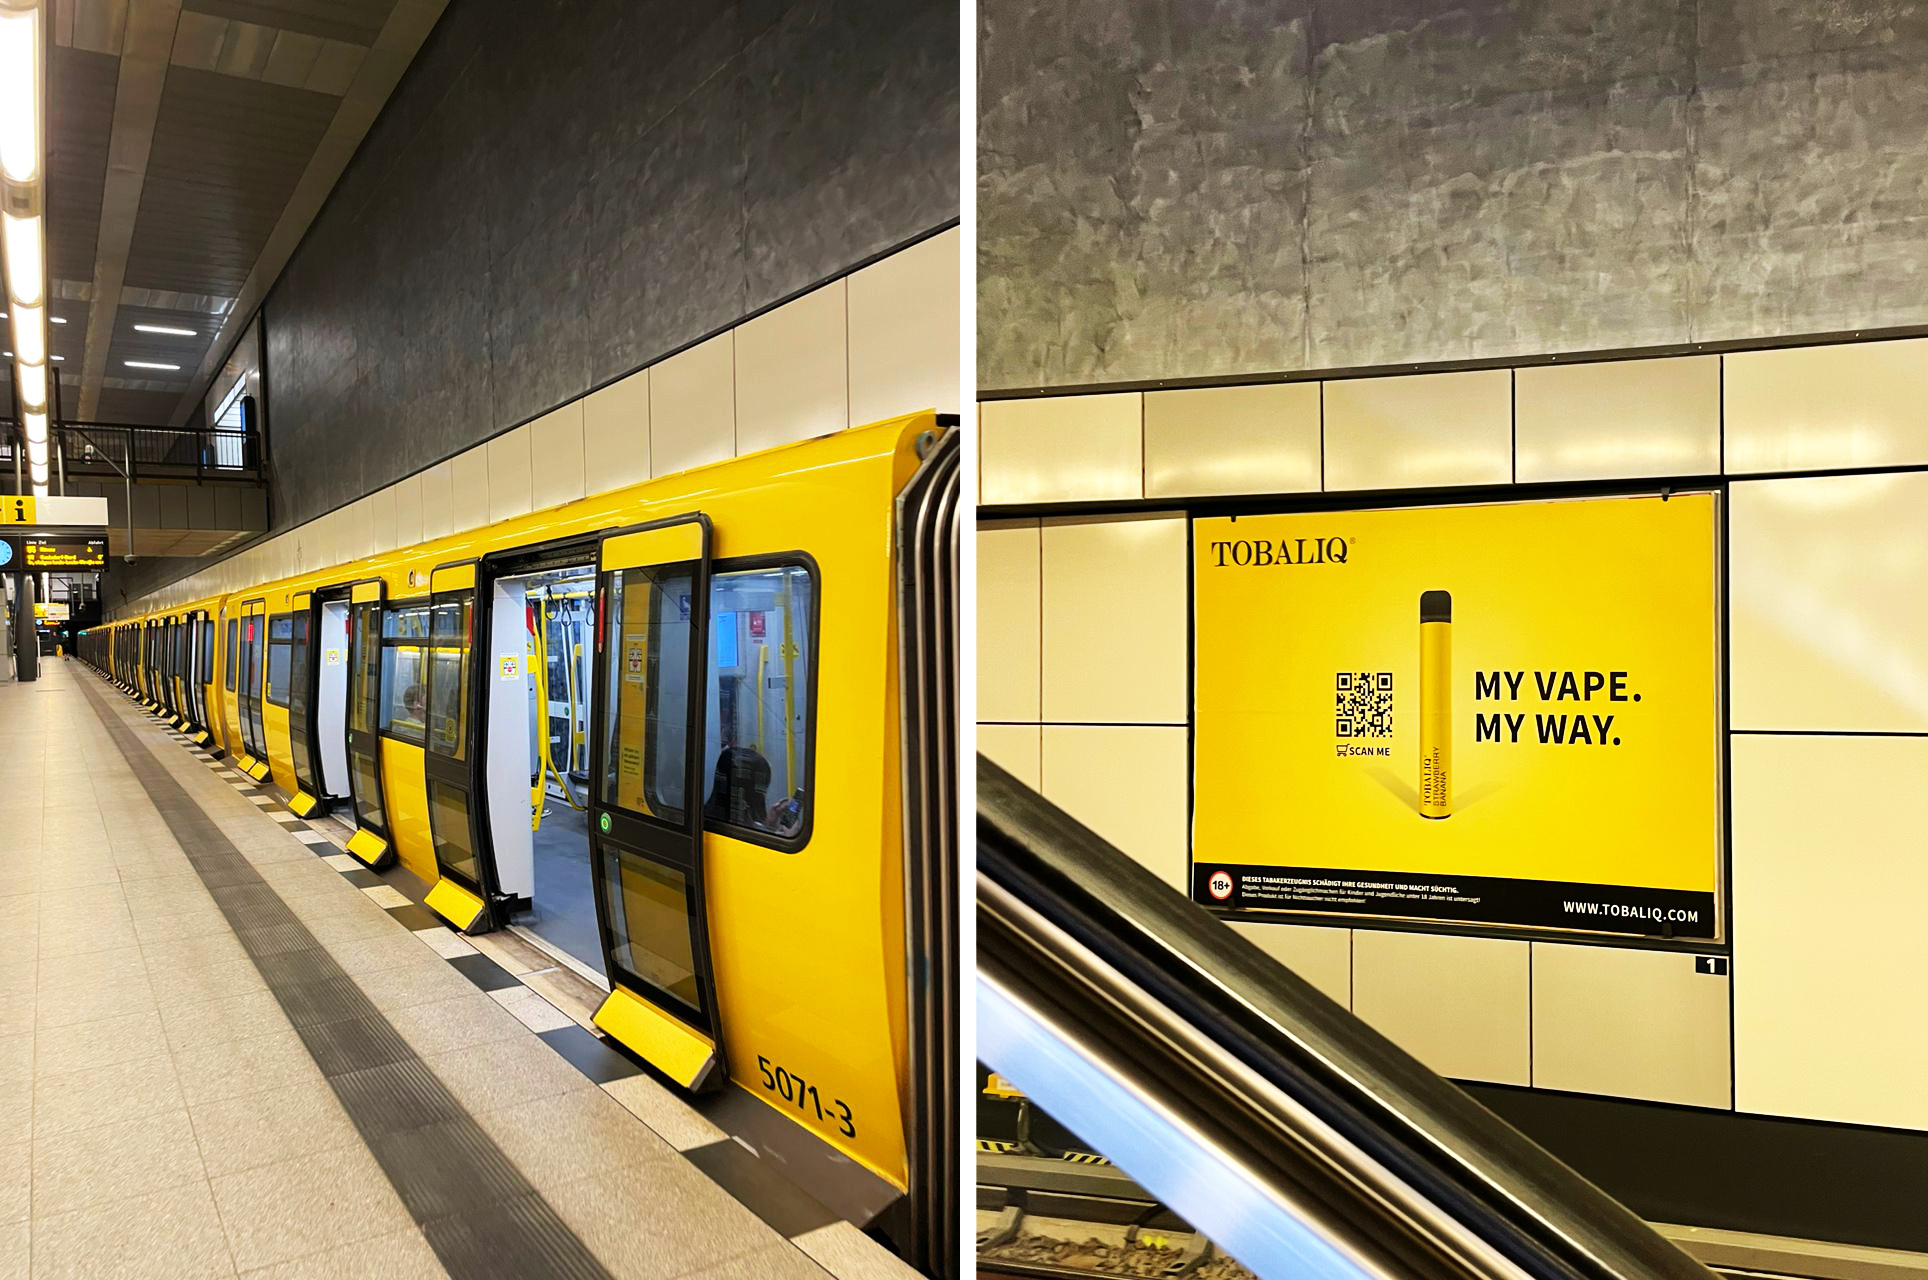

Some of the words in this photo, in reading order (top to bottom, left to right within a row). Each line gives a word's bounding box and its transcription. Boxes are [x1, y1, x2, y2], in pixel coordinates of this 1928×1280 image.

[1475, 671, 1525, 701] MY
[1534, 671, 1642, 702] VAPE.
[1475, 713, 1525, 744] MY
[1535, 714, 1621, 746] WAY.
[1349, 746, 1374, 756] SCAN
[1376, 747, 1391, 756] ME
[1432, 746, 1440, 806] STRAWBERRY
[1212, 880, 1231, 891] 18+
[1262, 877, 1312, 886] TABAKERZEUGNIS
[1312, 879, 1341, 887] SCHÄDIGT
[1356, 881, 1394, 890] GESUNDHEIT
[1409, 884, 1430, 892] MACHT
[1430, 885, 1460, 894] SÜCHTIG.
[1563, 901, 1699, 923] WWW.TOBALIQ.COM
[1706, 958, 1716, 974] 1
[757, 1054, 856, 1138] 5071-3
